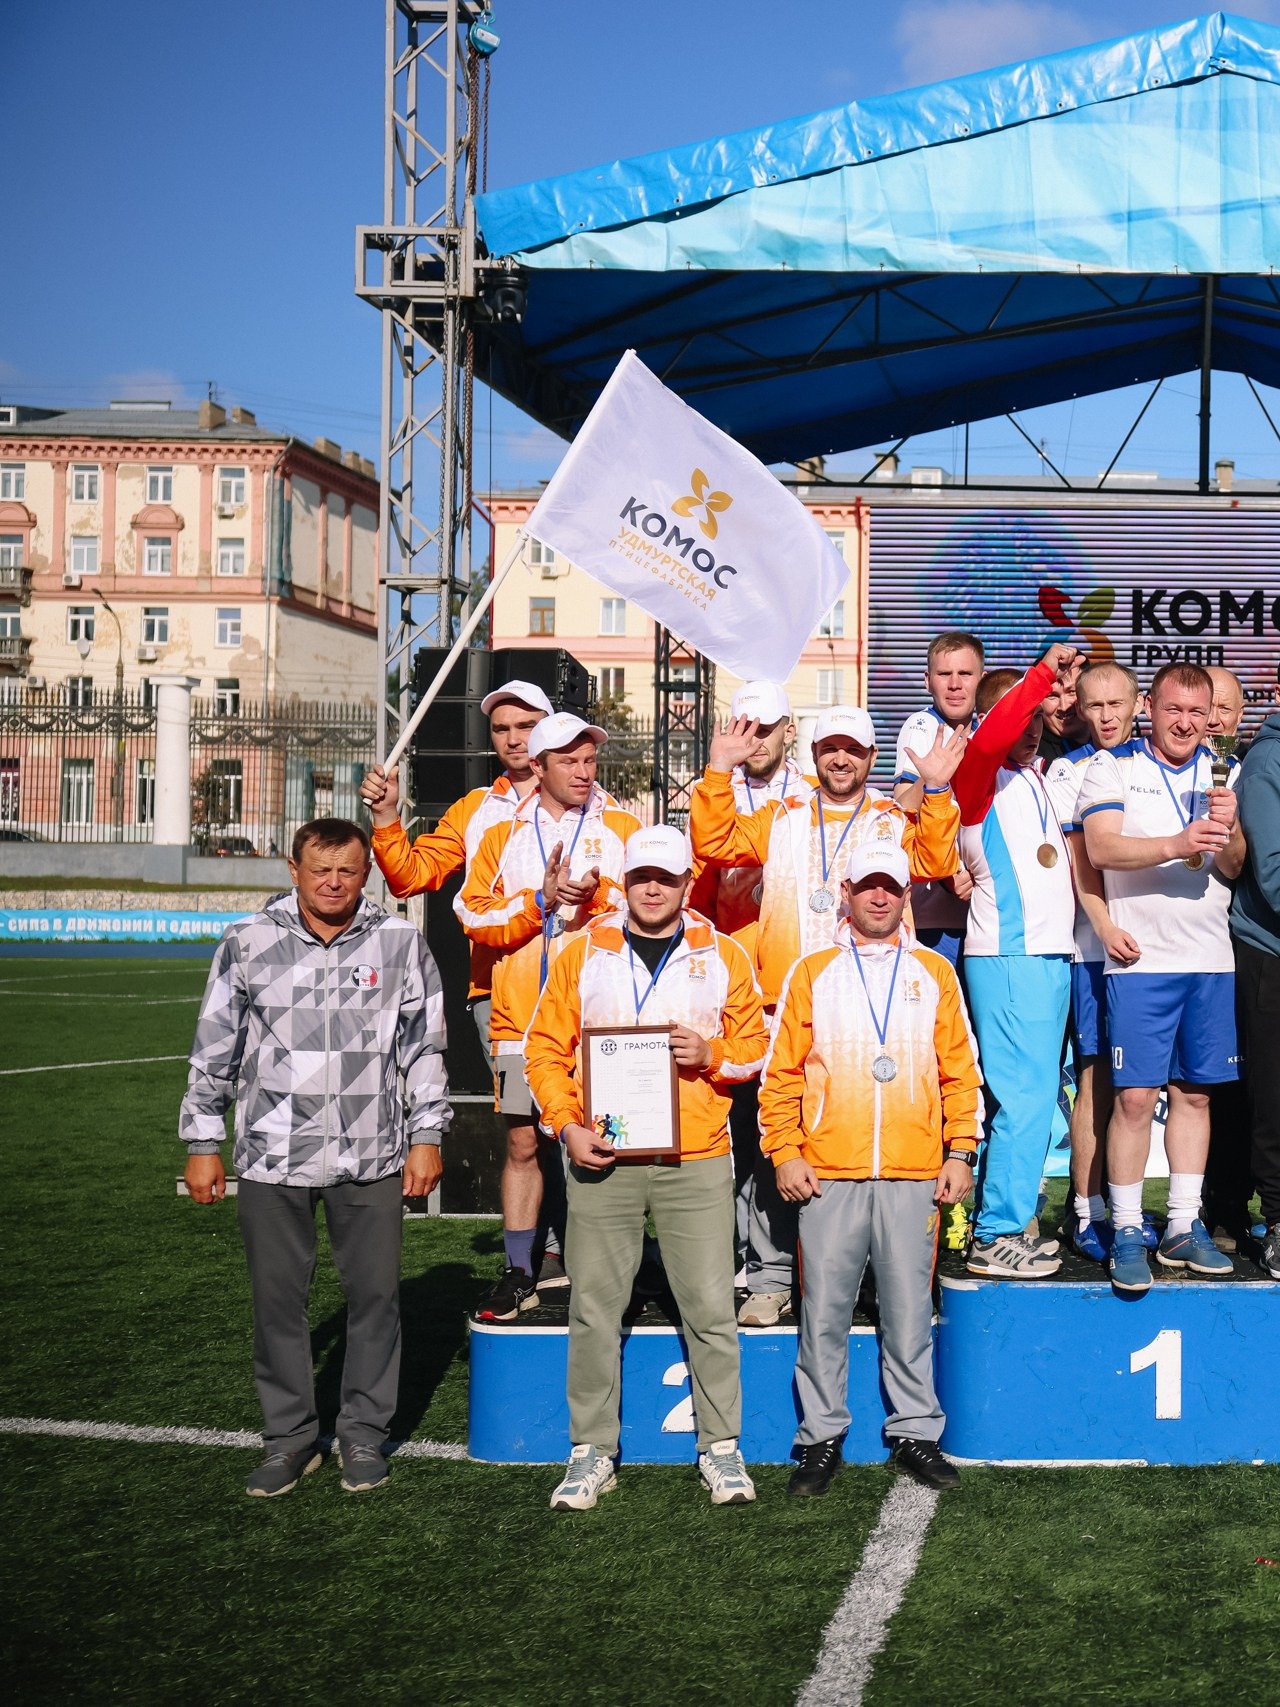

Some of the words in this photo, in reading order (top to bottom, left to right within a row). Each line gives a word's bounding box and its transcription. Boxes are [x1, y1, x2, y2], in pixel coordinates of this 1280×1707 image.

[618, 526, 716, 601] УДМУРТСКАЯ
[619, 496, 738, 590] КОМОС
[608, 539, 708, 611] ПТИЦЕФАБРИКА
[1131, 645, 1224, 667] ГРУПП
[1130, 785, 1162, 796] KELME
[156, 919, 167, 932] и
[170, 920, 231, 935] единст
[624, 1041, 668, 1051] ГРАМОТА
[1227, 1055, 1245, 1064] KEL
[662, 1361, 697, 1434] 2
[1130, 1329, 1182, 1420] 1
